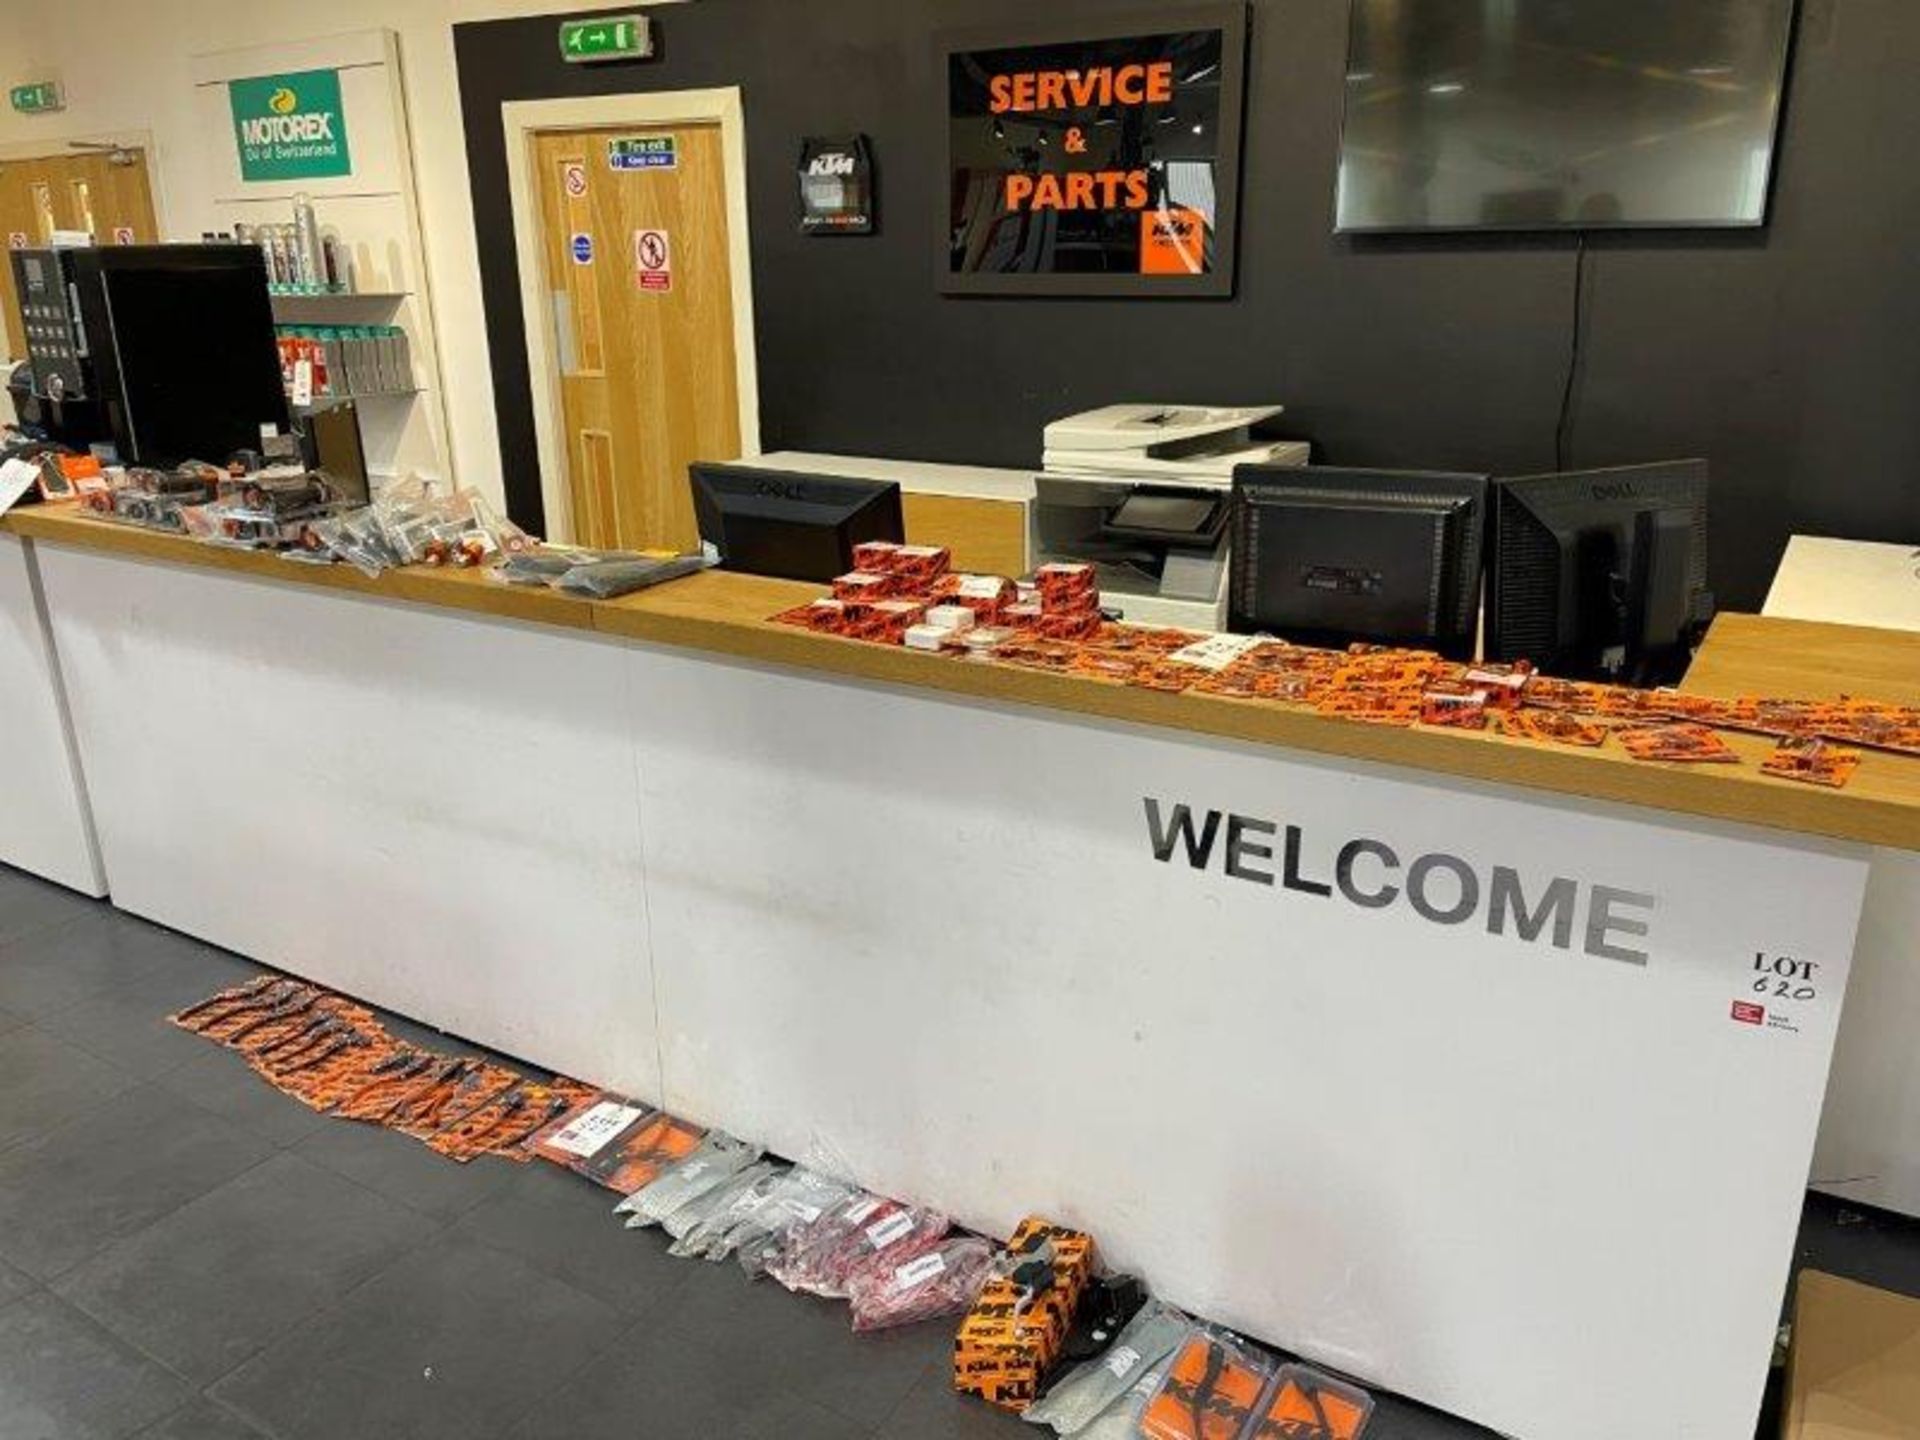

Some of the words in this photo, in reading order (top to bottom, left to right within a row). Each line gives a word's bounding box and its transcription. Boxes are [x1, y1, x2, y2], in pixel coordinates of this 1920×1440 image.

[990, 62, 1172, 114] SERVICE
[241, 112, 335, 145] MOTOREX
[1064, 127, 1087, 153] &
[808, 153, 855, 176] KTM
[1006, 169, 1149, 211] PARTS
[1143, 797, 1655, 967] WELCOME
[1753, 952, 1819, 982] LOT
[1753, 976, 1816, 1000] 620
